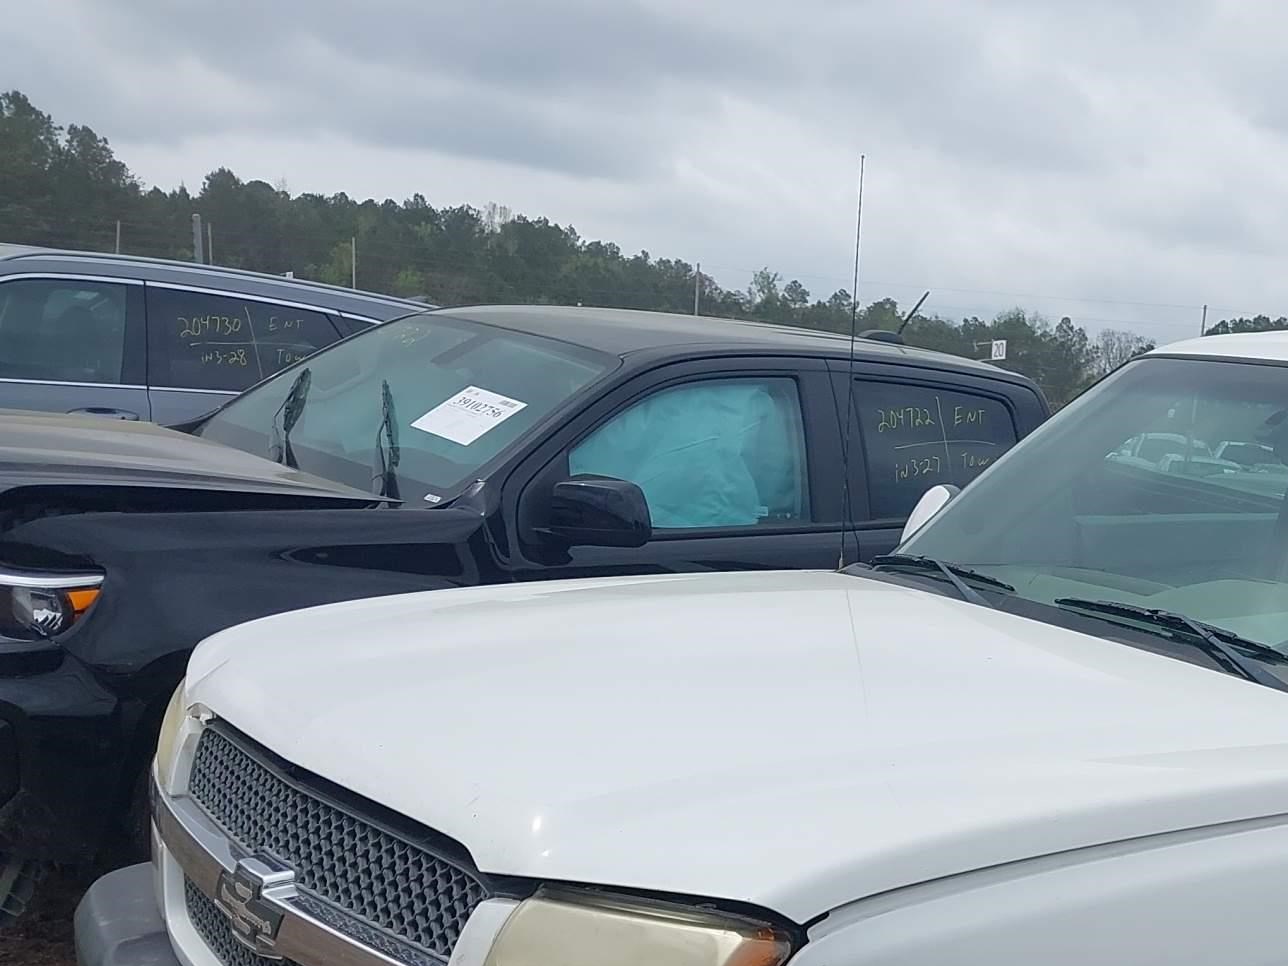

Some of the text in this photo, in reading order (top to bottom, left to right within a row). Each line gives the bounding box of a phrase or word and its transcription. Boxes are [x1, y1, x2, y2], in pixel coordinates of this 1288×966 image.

[177, 316, 242, 338] 204730
[993, 341, 1005, 358] 20
[453, 396, 504, 418] 39102756
[878, 406, 985, 433] 204722 ENT
